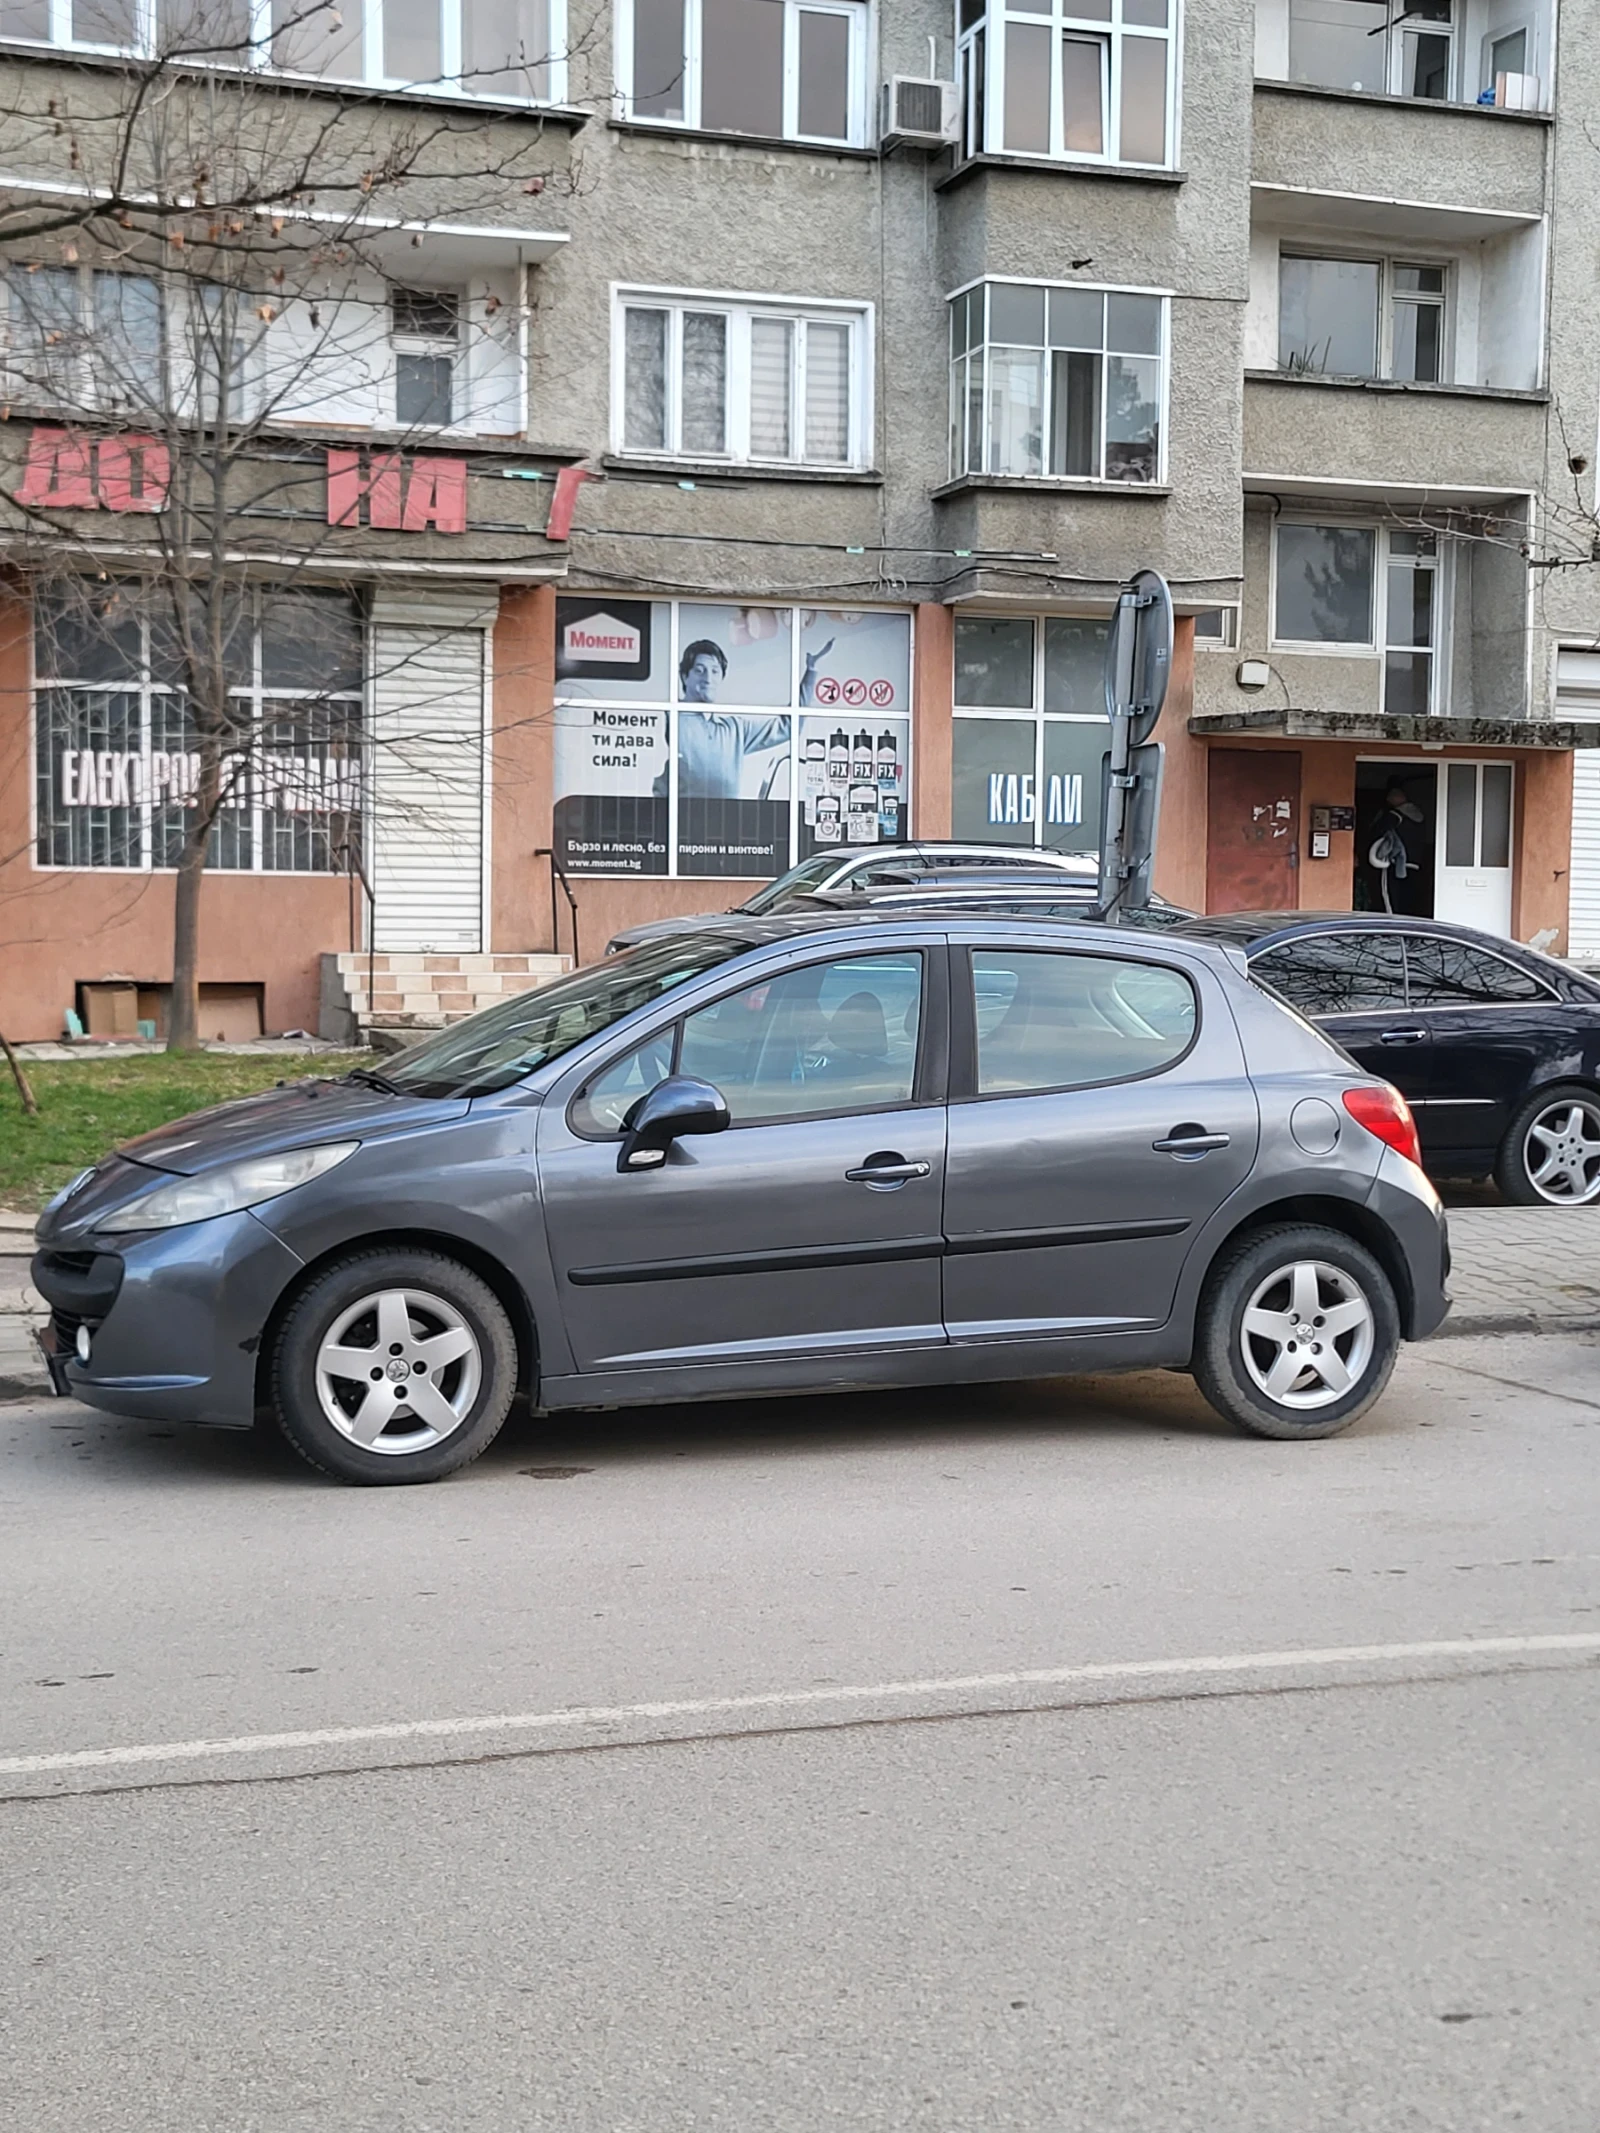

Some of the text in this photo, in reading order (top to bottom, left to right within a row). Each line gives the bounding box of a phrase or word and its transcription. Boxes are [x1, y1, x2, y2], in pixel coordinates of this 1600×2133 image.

[593, 711, 658, 727] Момент
[592, 734, 654, 748] ти дава
[592, 753, 637, 767] сила!
[831, 763, 848, 778] FIX
[854, 764, 871, 778] FIX
[878, 764, 895, 778] FIX
[568, 840, 774, 856] Бързо и лесно, без пирони и винтове!
[568, 859, 641, 869] www.moment.bg
